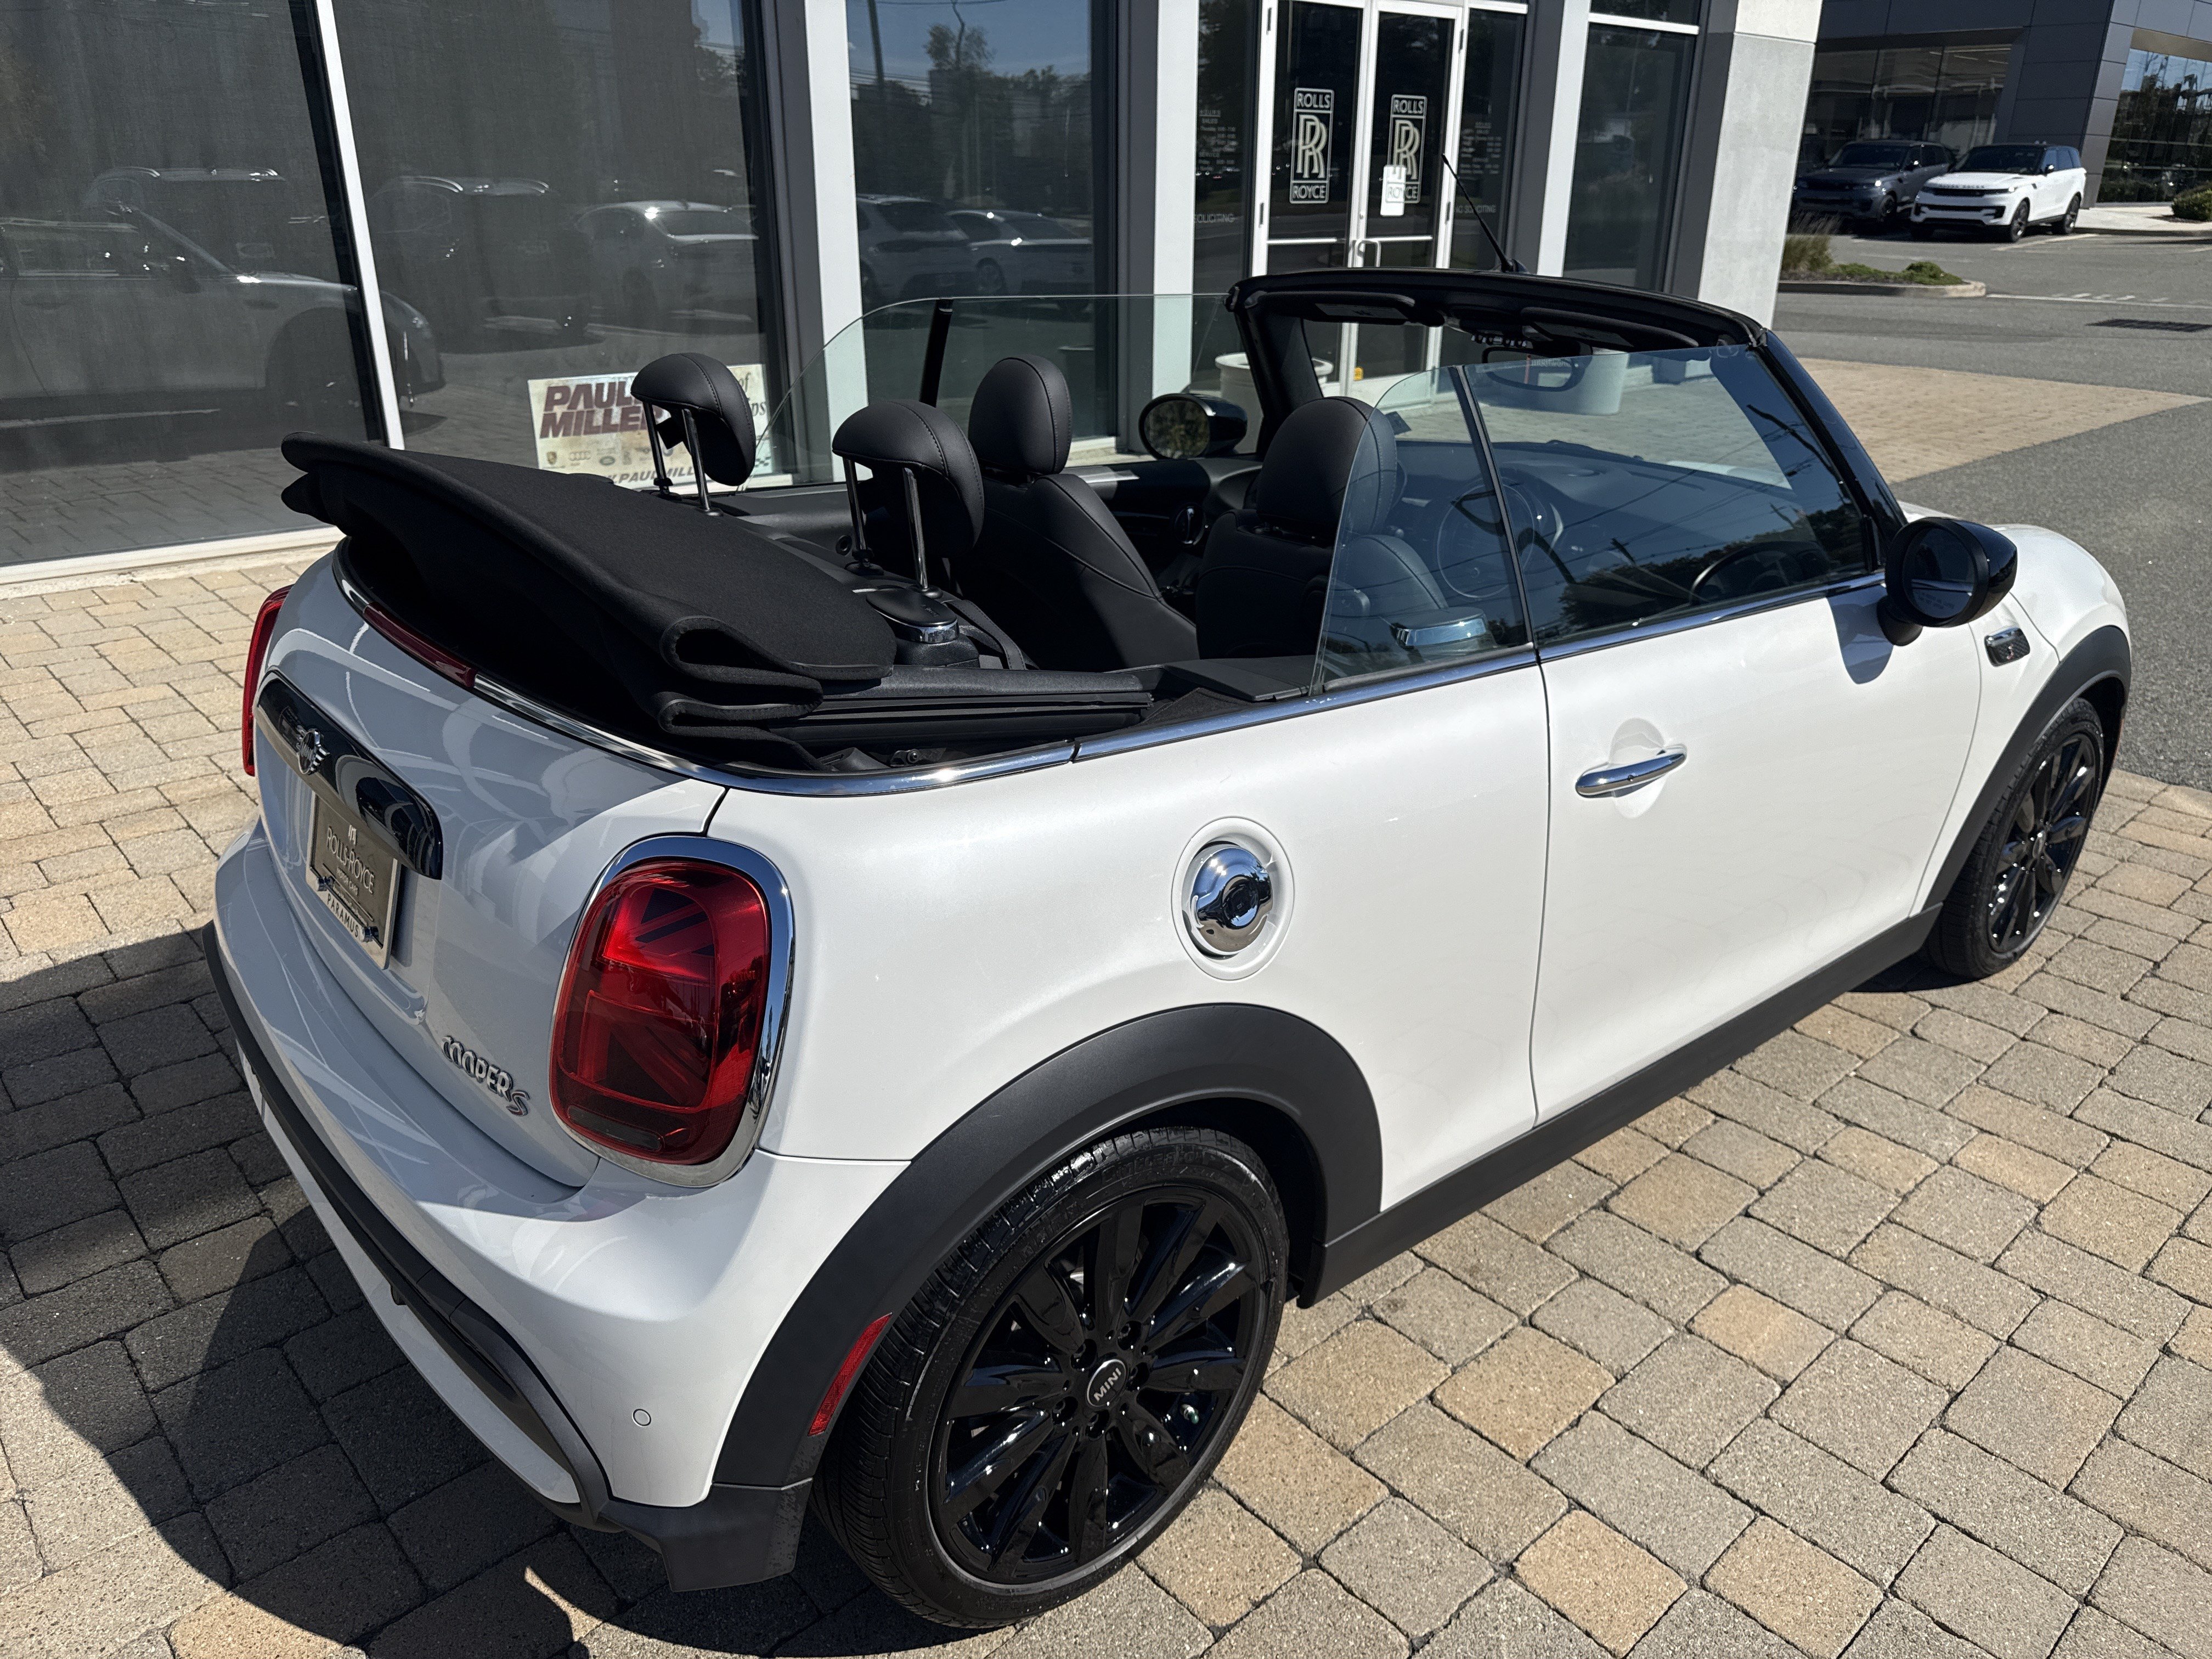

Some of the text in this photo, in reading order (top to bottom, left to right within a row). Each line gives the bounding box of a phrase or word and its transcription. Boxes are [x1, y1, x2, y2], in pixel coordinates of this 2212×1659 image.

[1296, 93, 1331, 109] ROLLS
[1393, 99, 1424, 114] ROLLS
[1293, 185, 1326, 199] ROYCE
[1195, 213, 1235, 223] OLICITING
[543, 381, 633, 412] PAUL
[326, 826, 375, 894] ROLLS-ROYCE
[326, 893, 359, 938] PARAMUS
[441, 1035, 531, 1116] COOPER S
[1093, 1367, 1122, 1402] MINI
